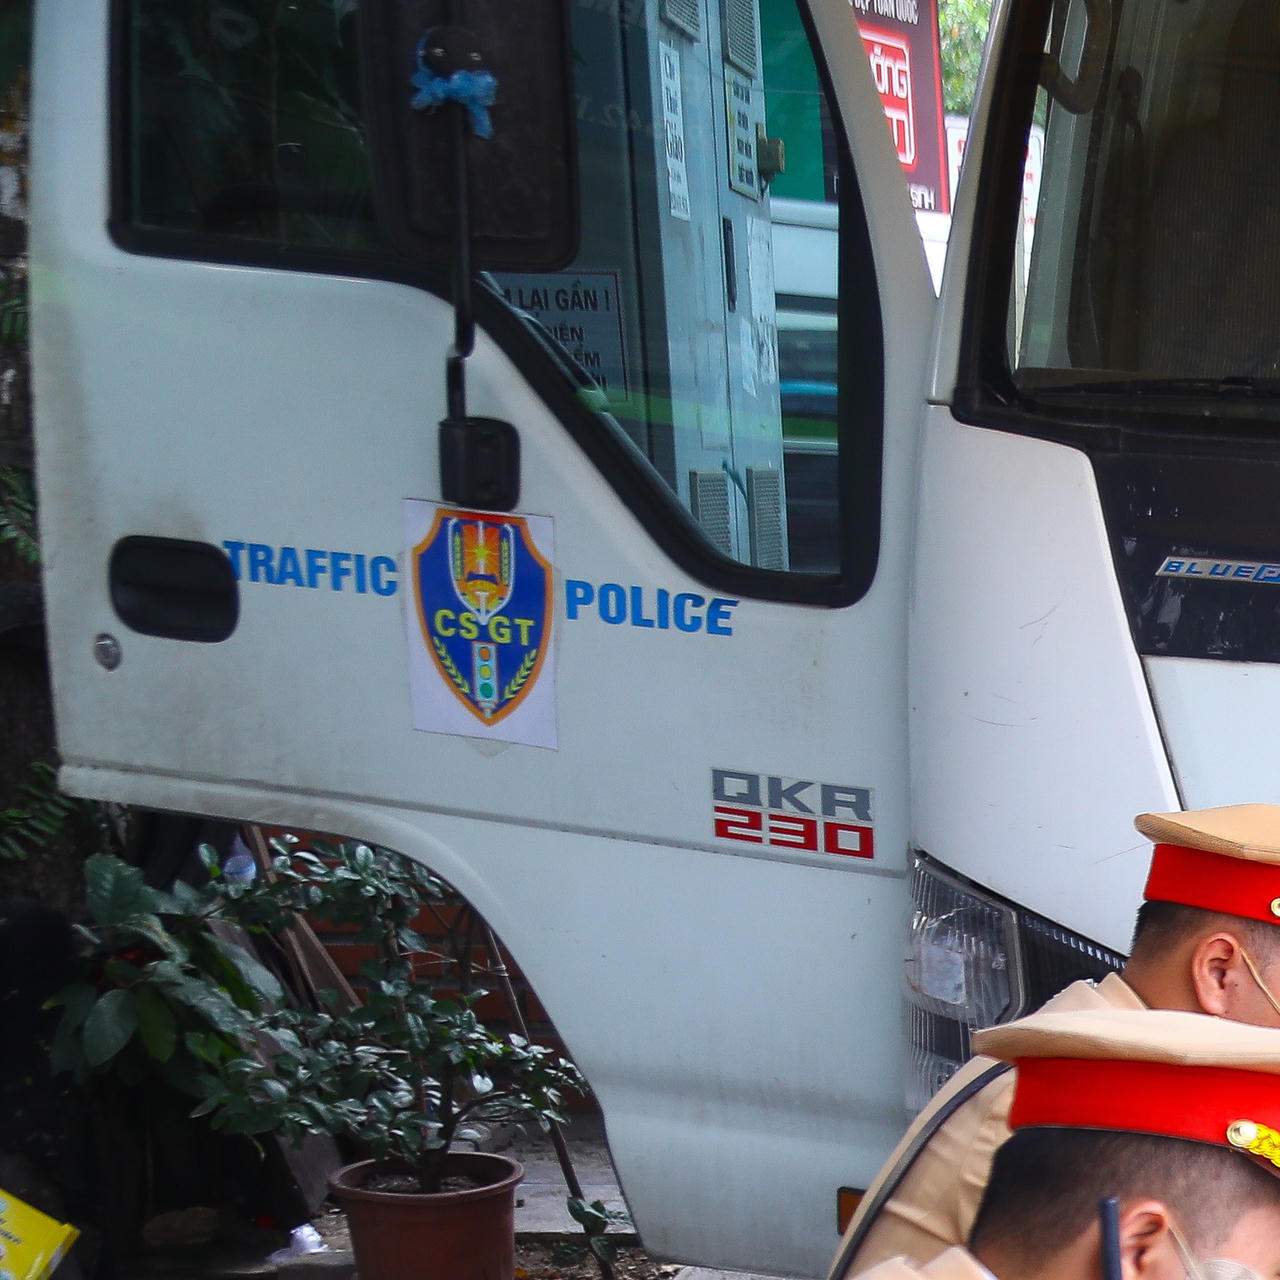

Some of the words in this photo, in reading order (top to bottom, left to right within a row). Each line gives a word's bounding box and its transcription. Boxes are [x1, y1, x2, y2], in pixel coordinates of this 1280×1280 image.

[222, 540, 398, 597] TRAFFIC
[565, 579, 740, 637] POLICE
[712, 768, 873, 822] QKR
[714, 805, 875, 860] 230
